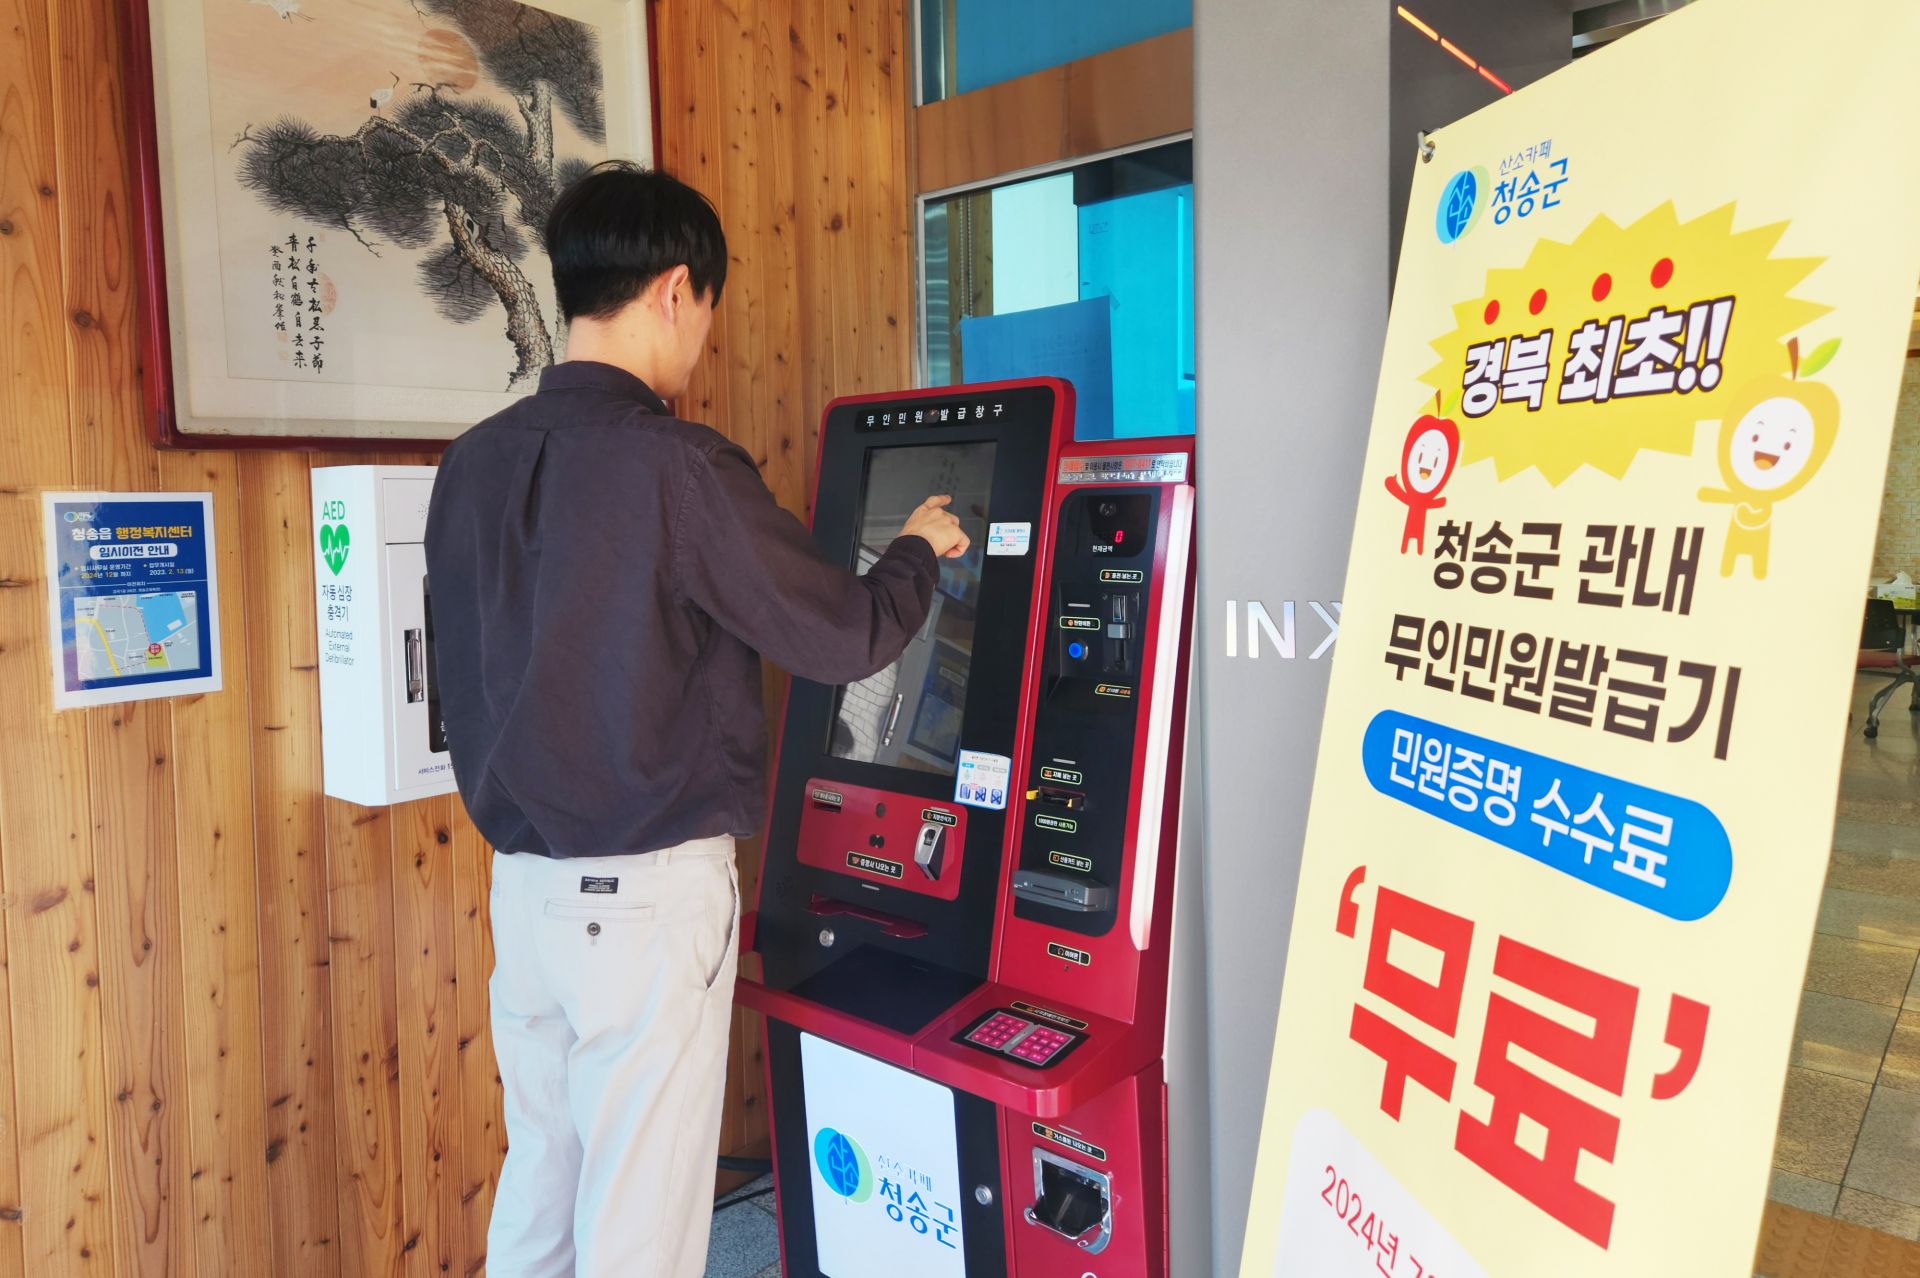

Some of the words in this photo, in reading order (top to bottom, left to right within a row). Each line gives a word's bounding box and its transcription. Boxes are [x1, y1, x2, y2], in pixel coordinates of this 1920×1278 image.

[1499, 139, 1552, 176] 산소카페
[1491, 157, 1569, 225] 청송군
[1461, 329, 1554, 418] 경북
[1557, 295, 1736, 405] 최초!!
[322, 501, 346, 521] AED
[72, 527, 112, 541] 청송읍
[116, 526, 193, 540] 행정복지센터
[1114, 530, 1124, 543] 0
[99, 546, 144, 558] 임시이전
[147, 545, 170, 556] 안내
[1092, 545, 1113, 553] 현재금액
[1433, 520, 1562, 600] 청송군
[1577, 524, 1705, 616] 관내
[327, 604, 349, 622] 충격기
[325, 628, 353, 640] Automated
[328, 641, 350, 652] External
[1384, 613, 1742, 761] 무인민원발급기
[1389, 727, 1523, 827] 민원증명
[1529, 778, 1674, 889] 수수료
[860, 858, 874, 869] 증명서
[875, 860, 890, 873] 나오는
[890, 865, 896, 874] 곳
[1060, 856, 1075, 866] 신용카드
[1064, 950, 1079, 960] 이어폰
[878, 1176, 959, 1250] 청송군
[1320, 1165, 1399, 1278] 2024년
